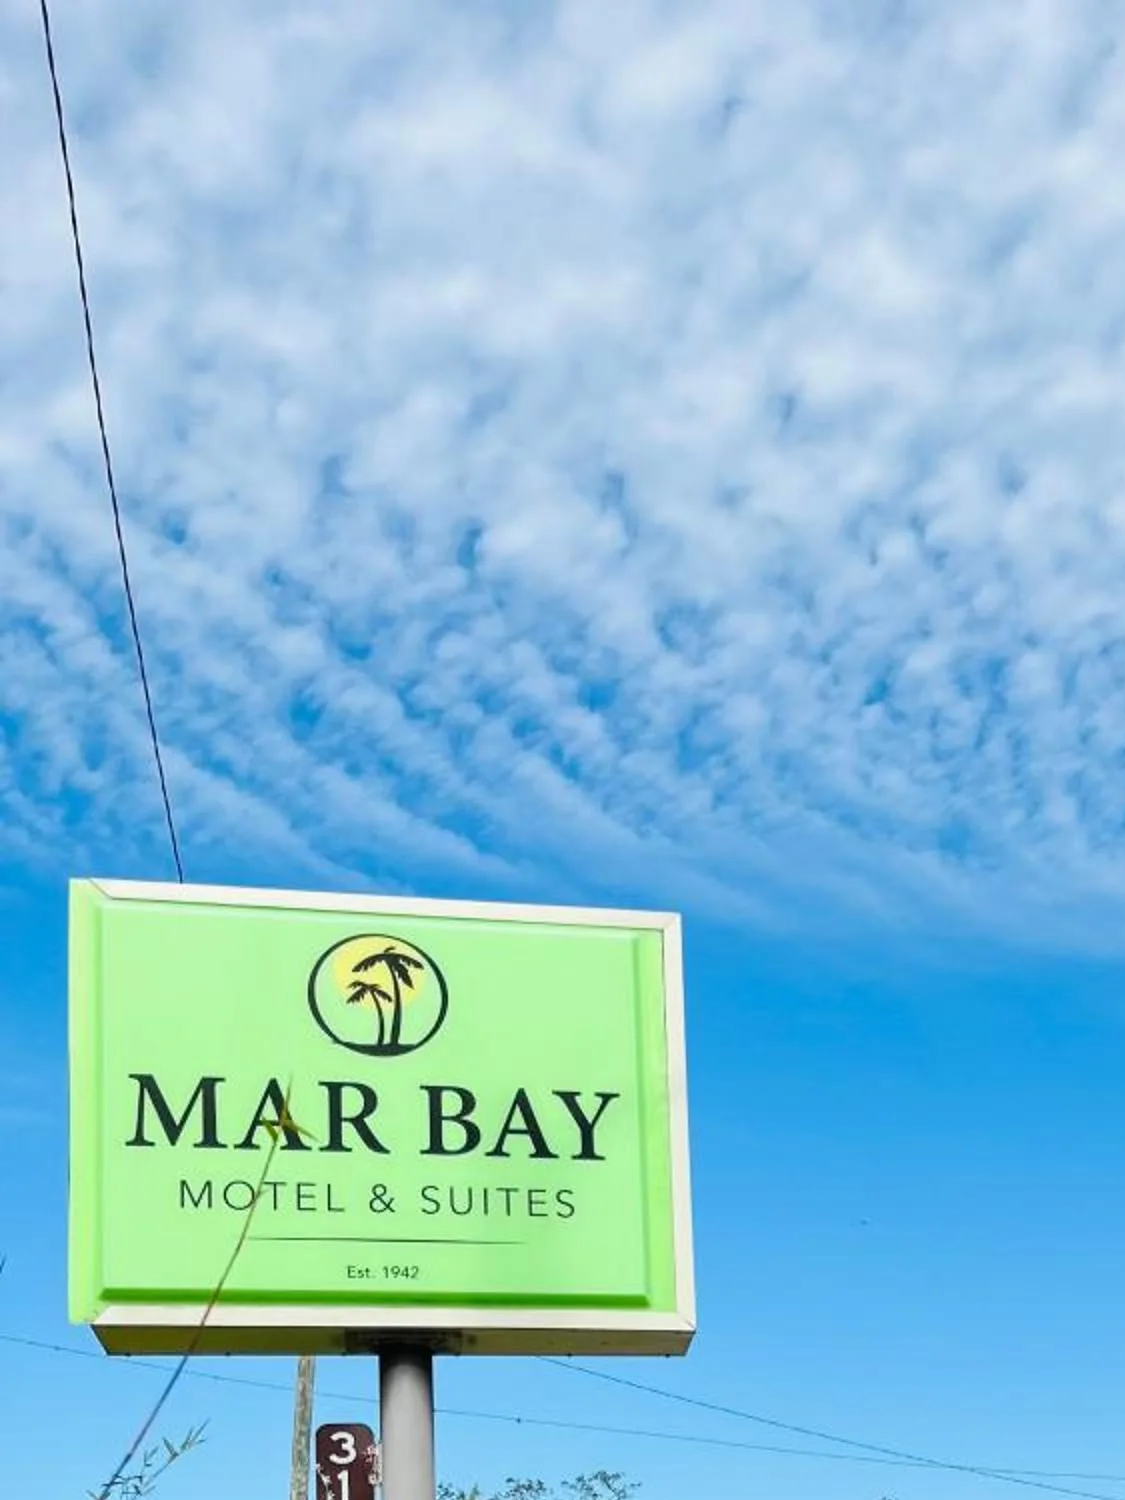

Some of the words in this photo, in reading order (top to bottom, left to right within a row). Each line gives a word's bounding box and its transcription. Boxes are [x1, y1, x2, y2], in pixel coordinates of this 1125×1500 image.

[125, 1072, 391, 1155] MAR
[419, 1084, 621, 1161] BAY
[179, 1178, 346, 1214] MOTEL
[368, 1182, 397, 1215] &
[420, 1184, 577, 1219] SUITES
[382, 1264, 420, 1280] 1942
